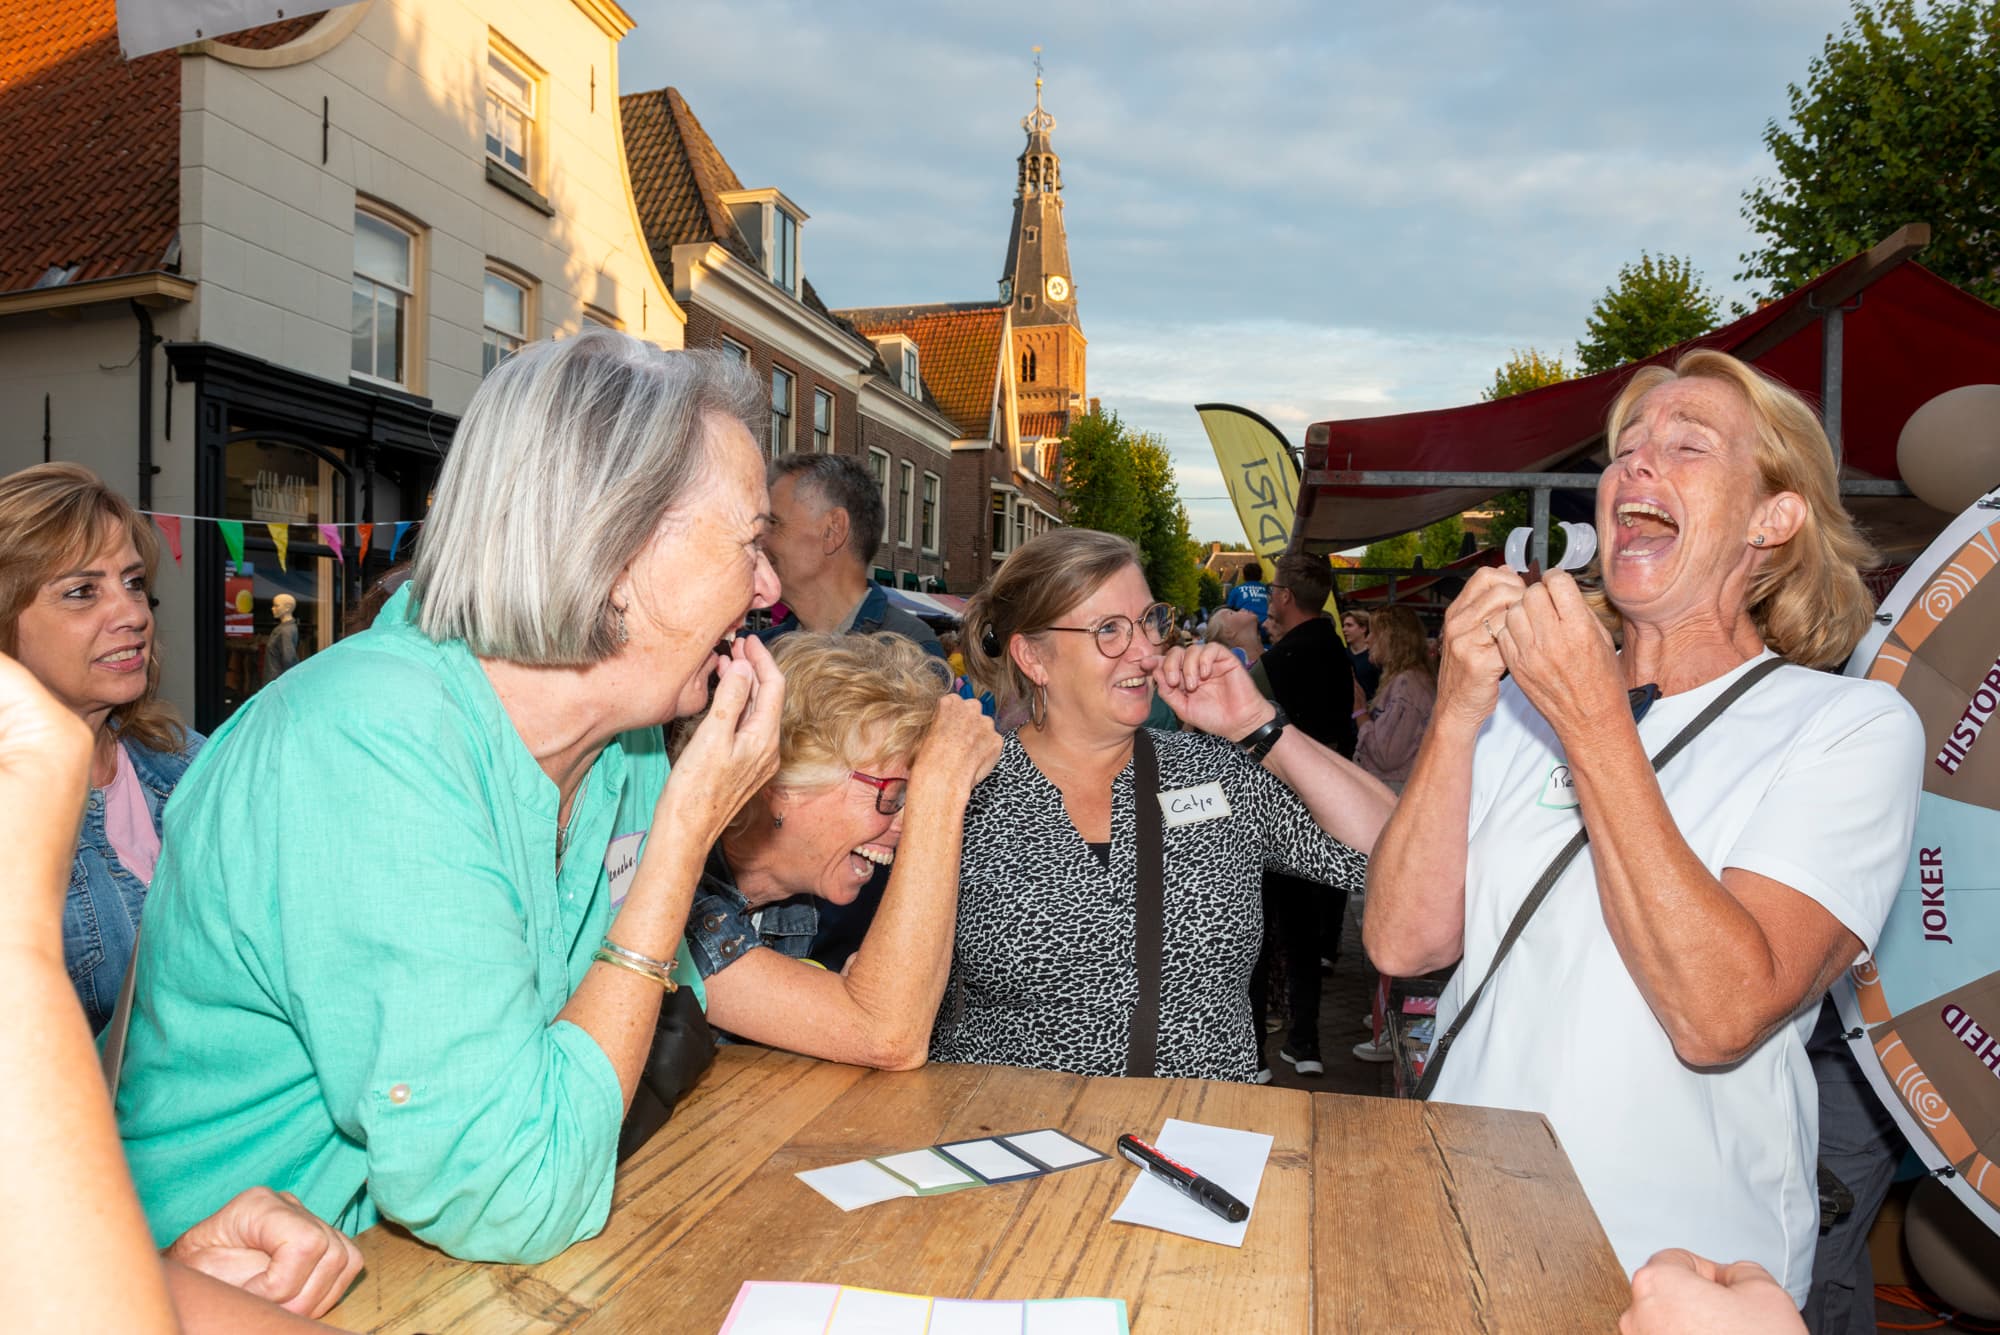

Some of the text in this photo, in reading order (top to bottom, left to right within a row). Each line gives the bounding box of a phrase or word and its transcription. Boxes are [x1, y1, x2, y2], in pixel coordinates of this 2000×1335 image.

[1935, 657, 2000, 776] HISTOR
[1919, 846, 1953, 945] JOKER
[1941, 1004, 2000, 1078] HEID
